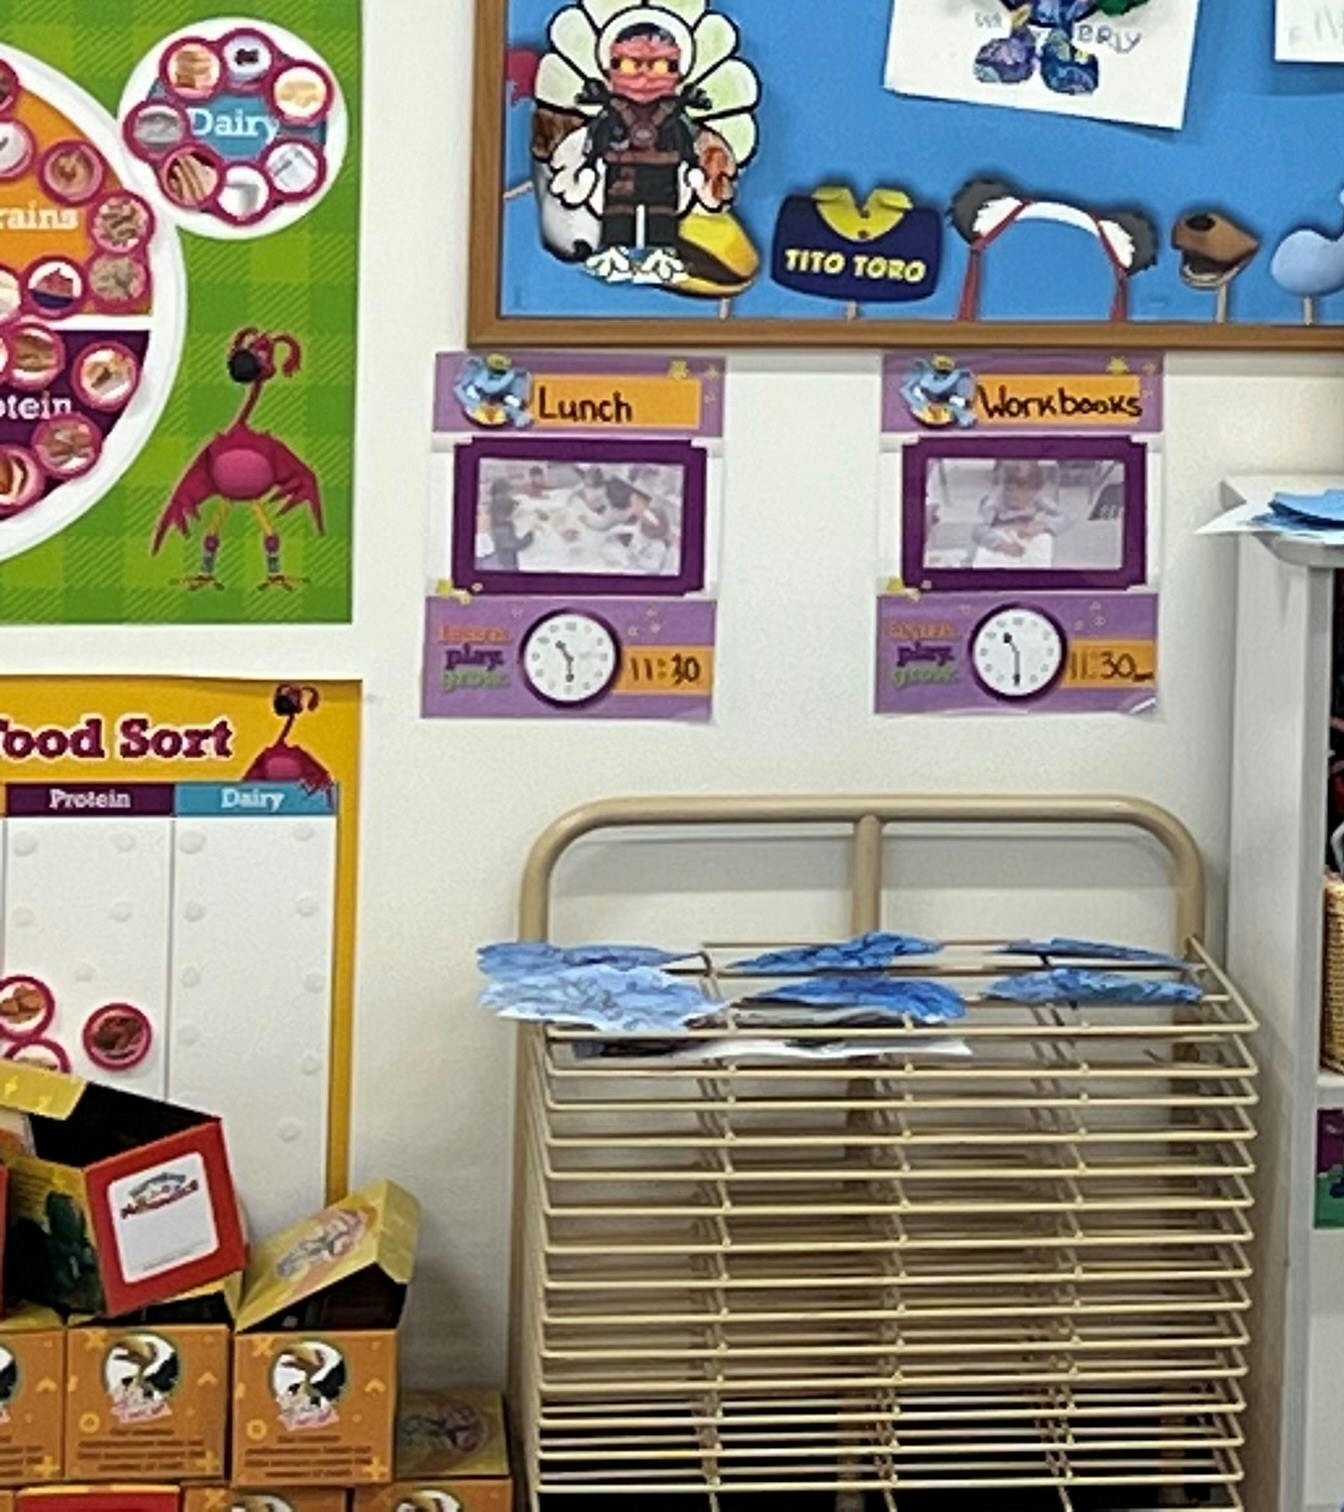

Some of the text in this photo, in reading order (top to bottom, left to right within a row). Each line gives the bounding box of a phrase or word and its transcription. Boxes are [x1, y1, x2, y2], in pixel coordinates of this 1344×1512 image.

[188, 106, 280, 144] Dairy
[783, 246, 926, 283] TITO TORO
[538, 386, 633, 425] Lunch
[979, 384, 1143, 420] Workbooks
[628, 653, 702, 686] 11:30
[1070, 651, 1137, 682] 11:30
[119, 716, 234, 760] Sort
[48, 789, 131, 810] Protein
[220, 789, 286, 813] Dairy
